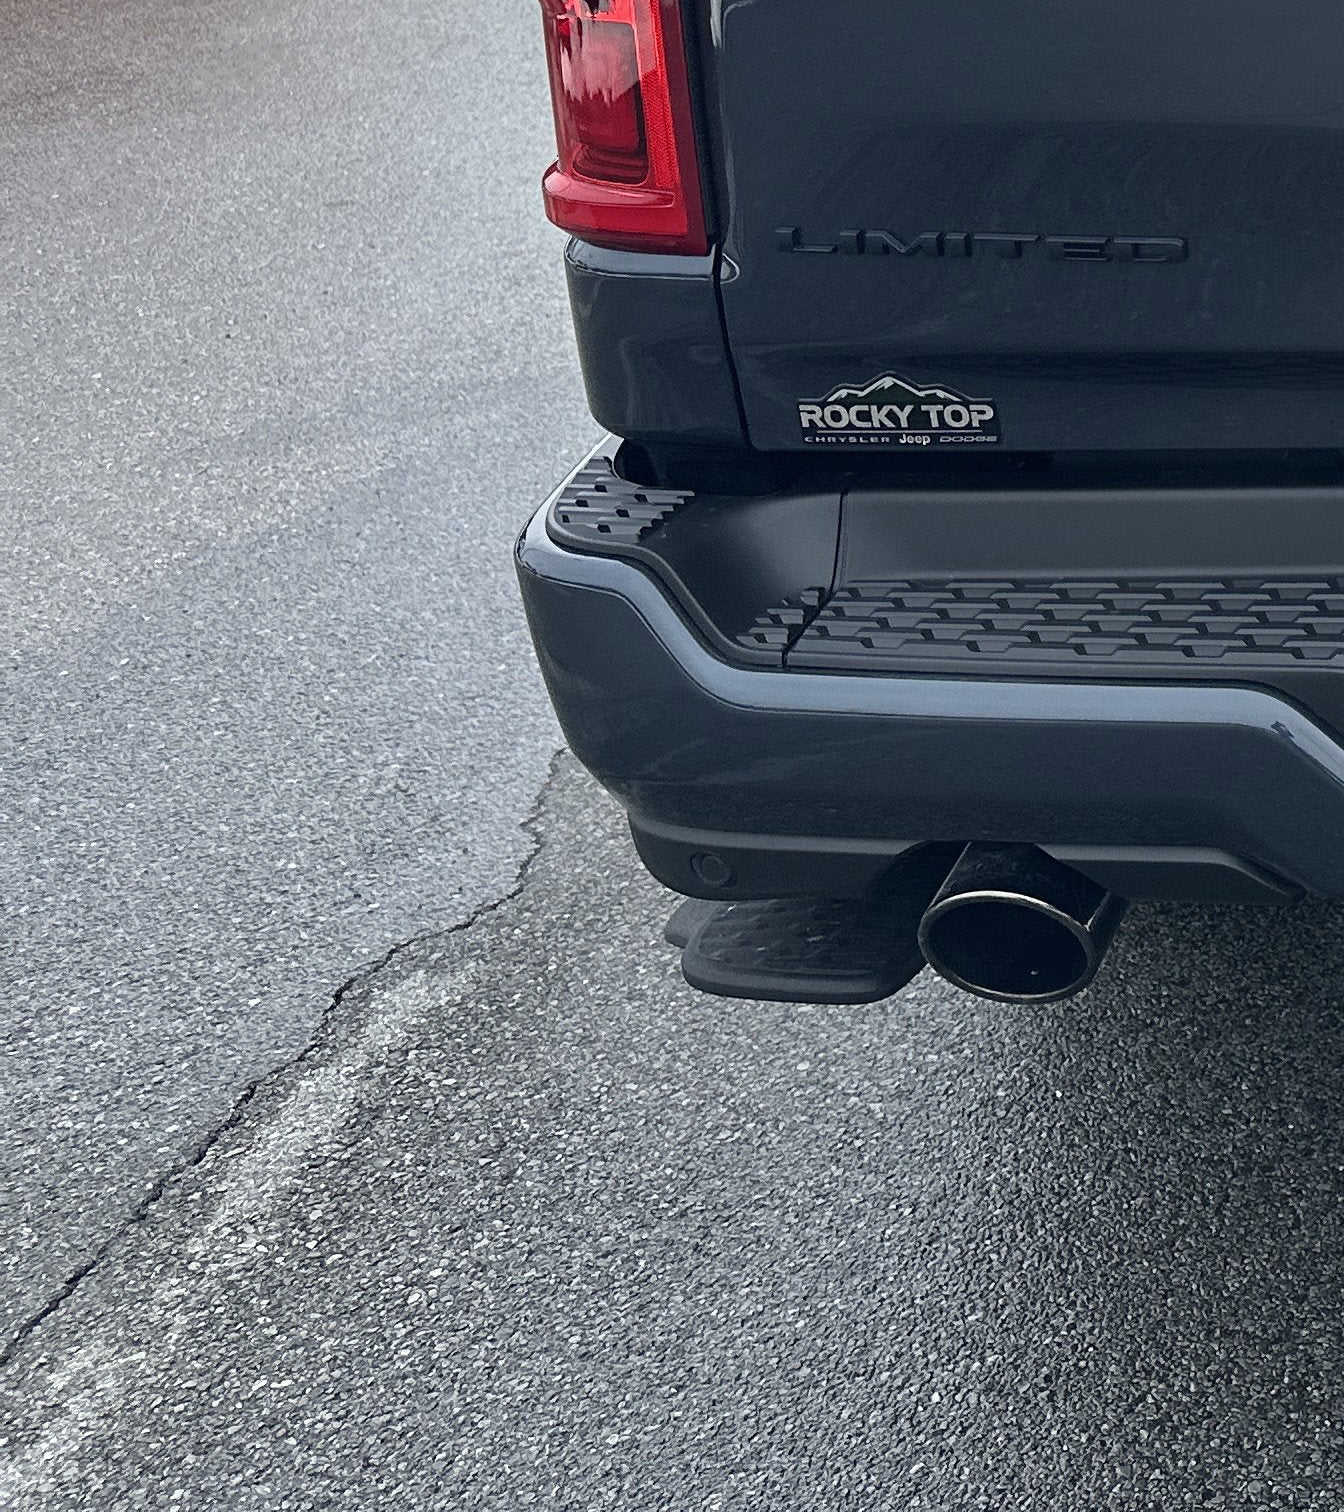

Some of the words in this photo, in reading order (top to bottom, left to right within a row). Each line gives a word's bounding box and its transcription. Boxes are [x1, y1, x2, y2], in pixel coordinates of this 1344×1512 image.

[775, 226, 1192, 263] LIMITED
[798, 404, 914, 429] ROCKY
[920, 404, 994, 429] TOP
[899, 434, 931, 445] Jeep
[939, 435, 998, 443] DODGE
